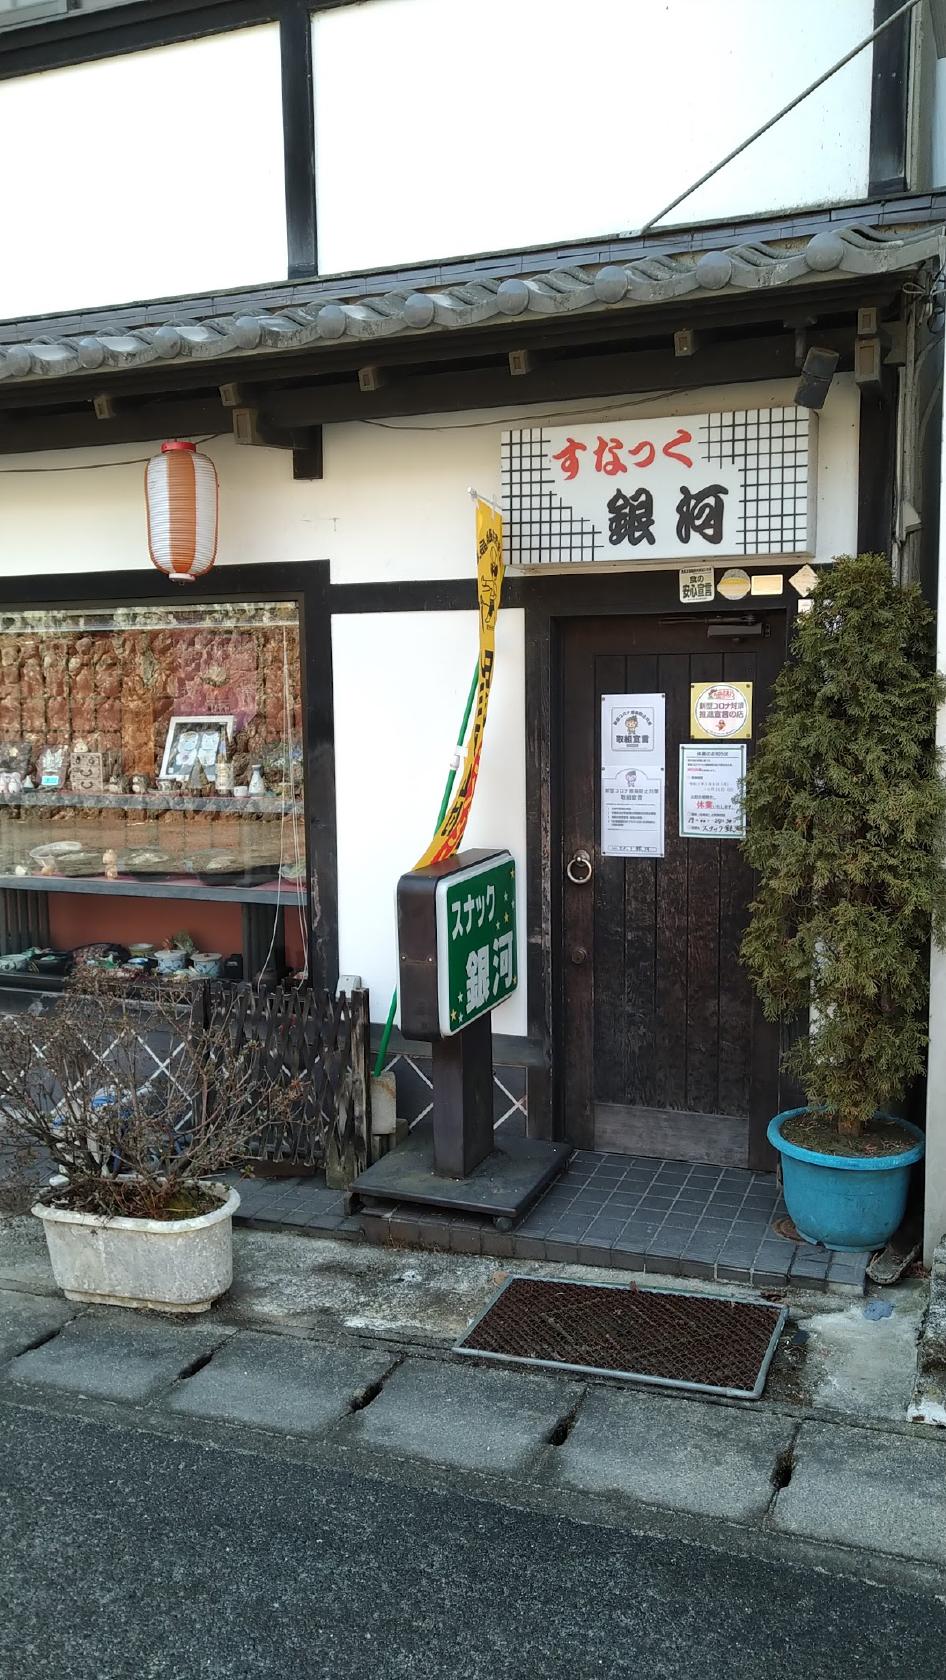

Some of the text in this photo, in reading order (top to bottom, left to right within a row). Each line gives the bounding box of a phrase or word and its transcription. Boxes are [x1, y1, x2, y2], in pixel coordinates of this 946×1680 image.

[552, 429, 693, 480] すなっく
[606, 484, 729, 546] 銀河
[682, 583, 713, 598] 安心宣言
[690, 575, 705, 583] 食の
[451, 884, 495, 941] スナック
[465, 930, 514, 1014] 銀河
